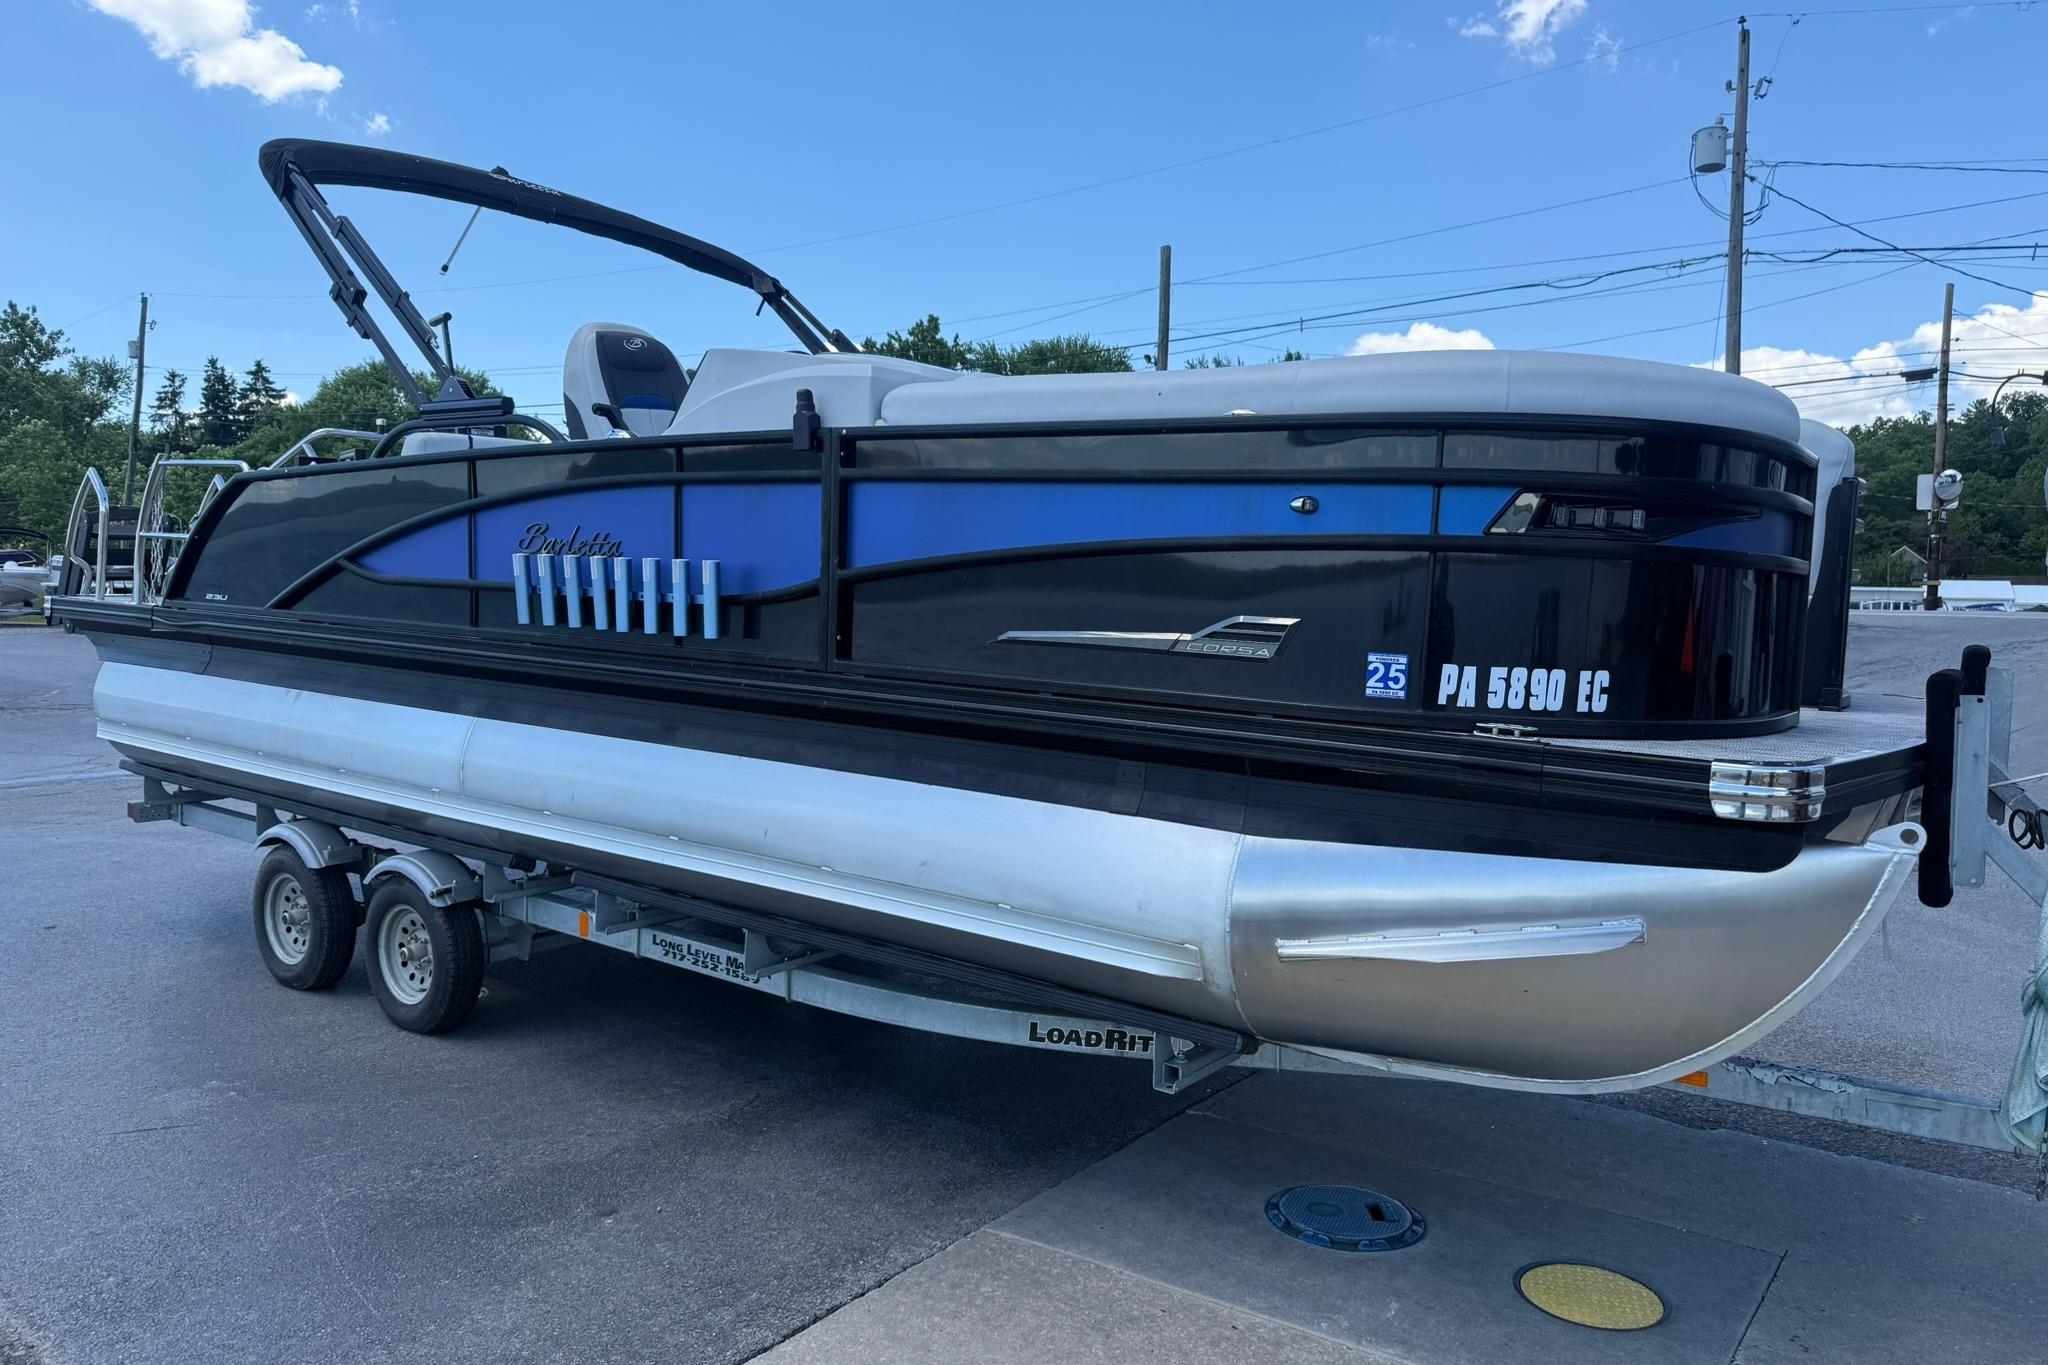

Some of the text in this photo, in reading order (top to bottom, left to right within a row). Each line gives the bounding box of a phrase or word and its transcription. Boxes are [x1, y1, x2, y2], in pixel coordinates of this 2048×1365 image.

[518, 521, 624, 557] Barletta
[1186, 643, 1270, 657] CORSA
[1366, 662, 1406, 690] 25
[1437, 663, 1610, 713] PA 5890 EC
[652, 934, 722, 965] LONG LEVEL
[1028, 1021, 1154, 1053] LOADRIT
